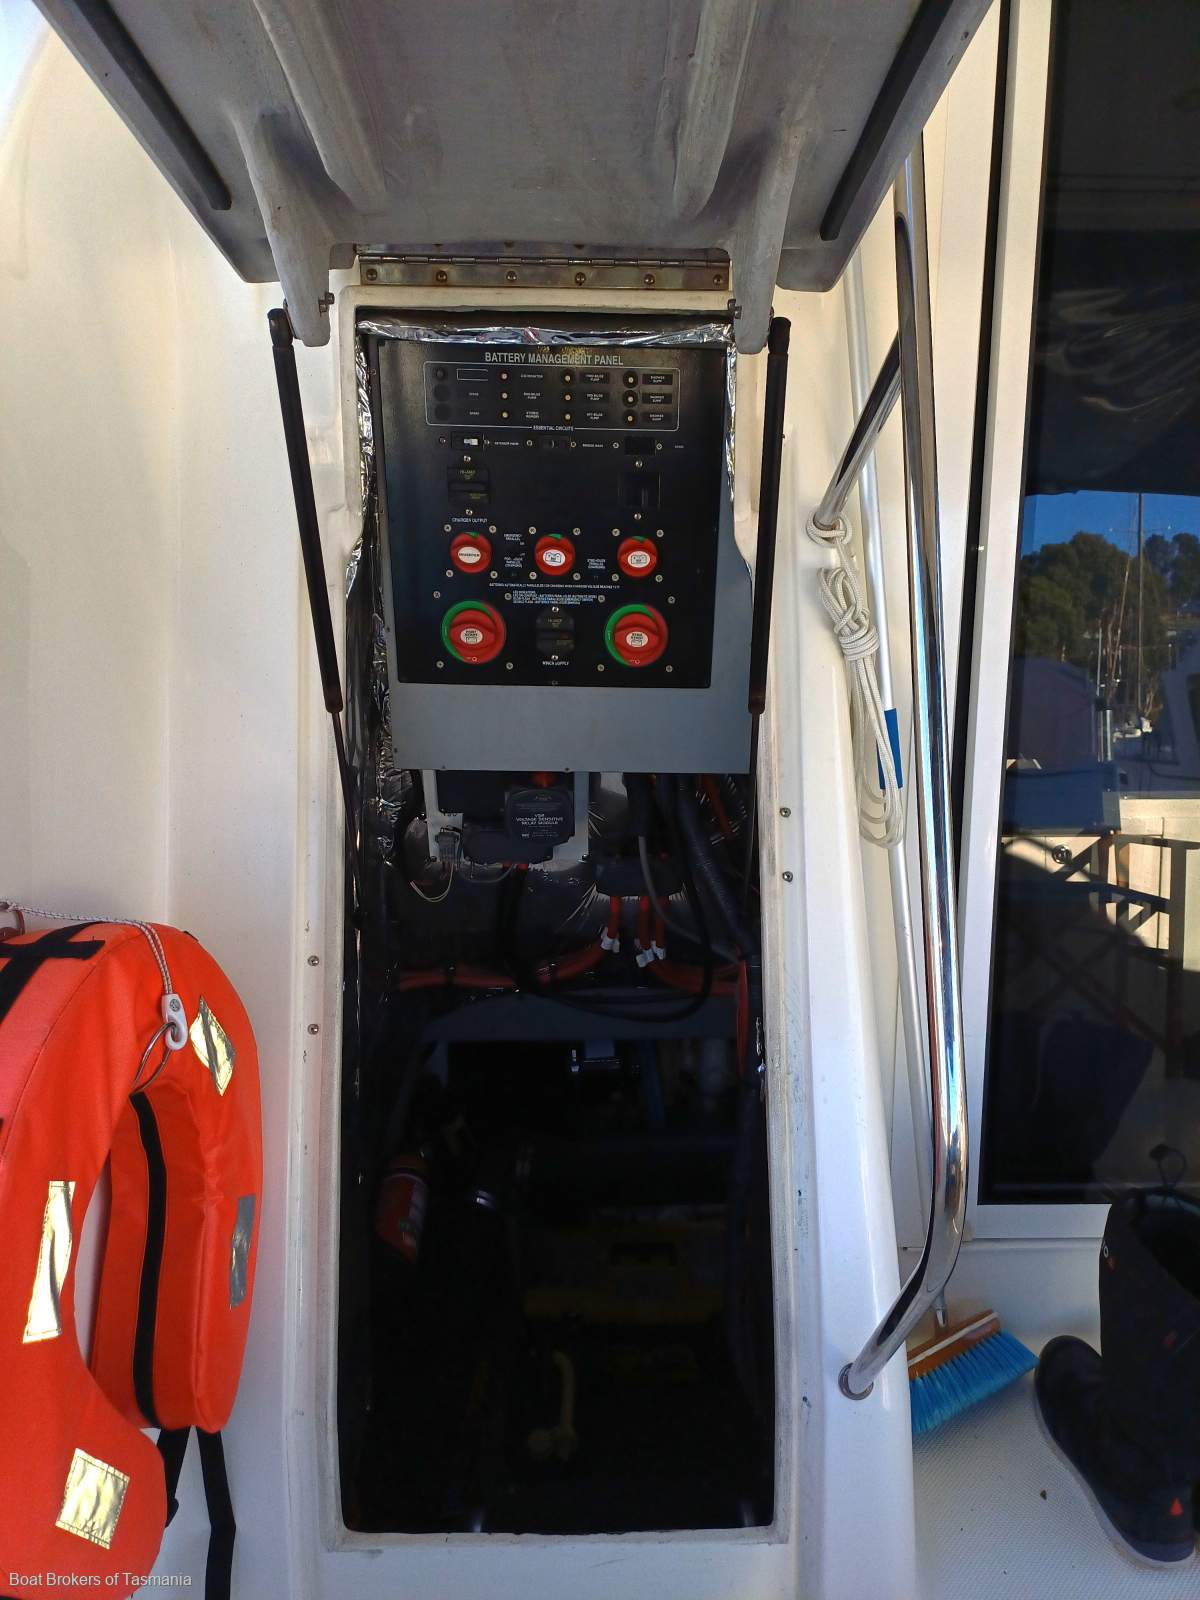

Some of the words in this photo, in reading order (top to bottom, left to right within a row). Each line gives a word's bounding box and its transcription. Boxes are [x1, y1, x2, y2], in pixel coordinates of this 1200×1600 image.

[485, 352, 526, 363] BATTERY
[528, 353, 592, 364] MANAGEMENT
[594, 355, 624, 366] PANEL
